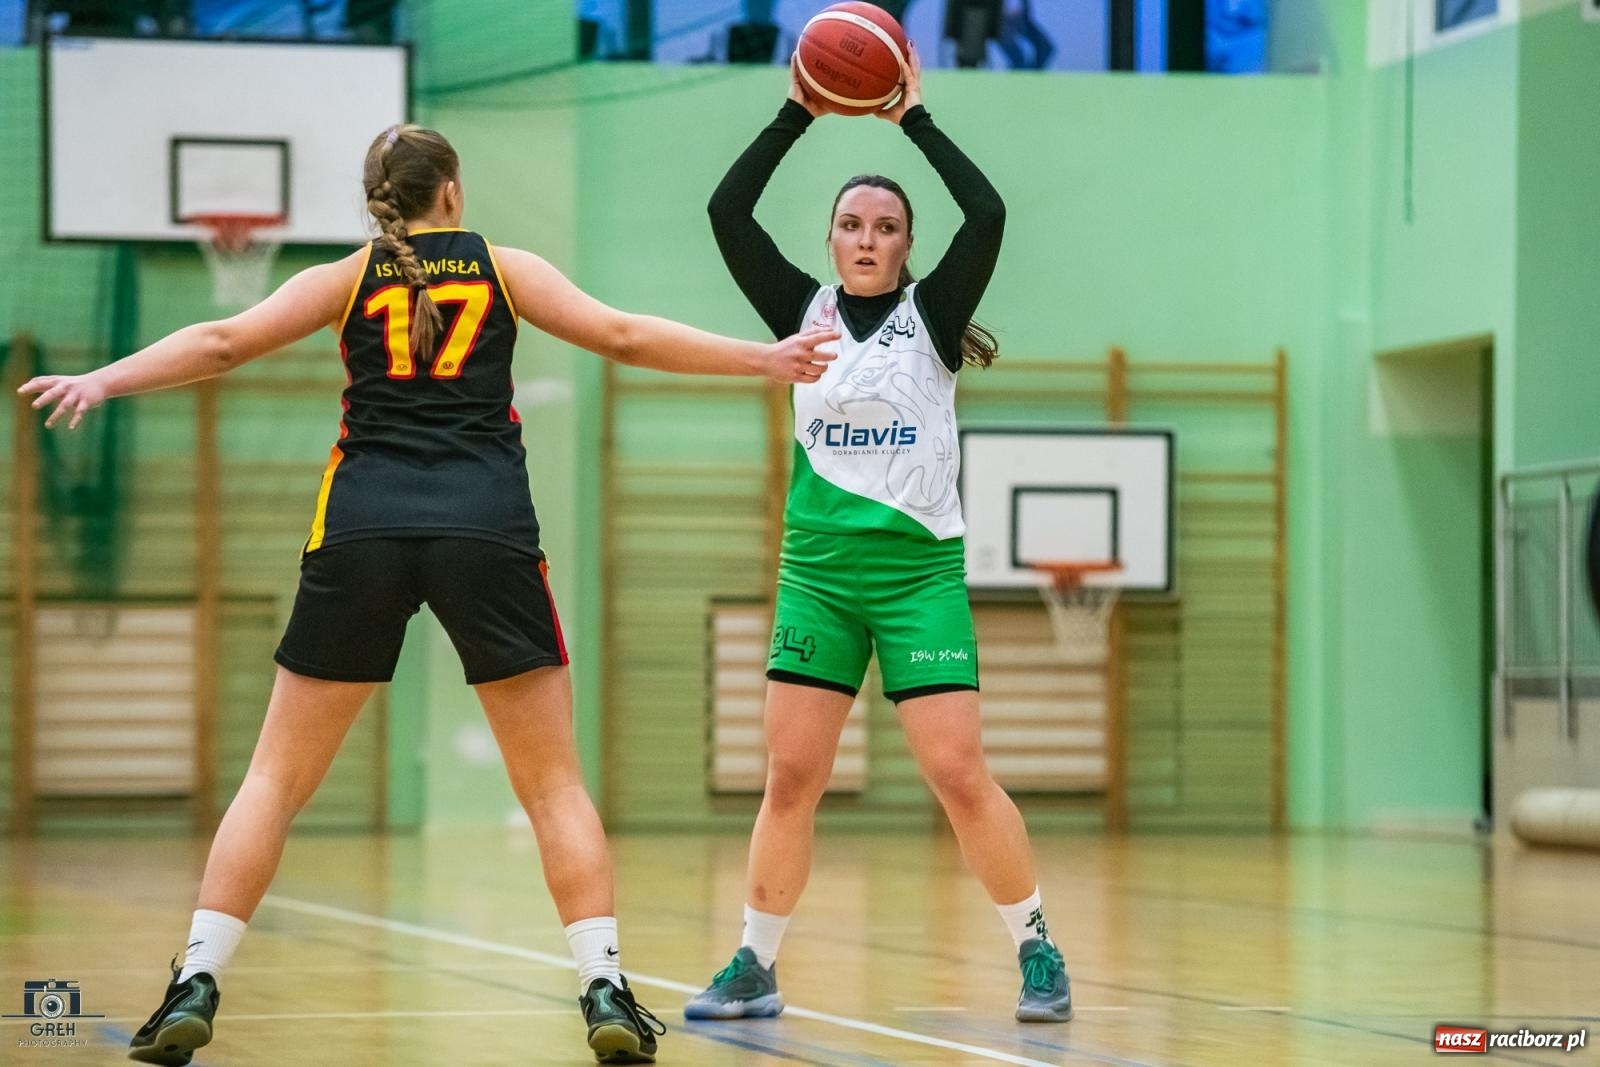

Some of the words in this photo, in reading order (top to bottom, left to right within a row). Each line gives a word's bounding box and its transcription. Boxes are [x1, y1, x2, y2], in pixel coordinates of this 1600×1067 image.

[422, 258, 481, 276] WISŁA
[363, 280, 494, 380] 17
[878, 315, 916, 347] 24
[825, 420, 917, 447] Clavis
